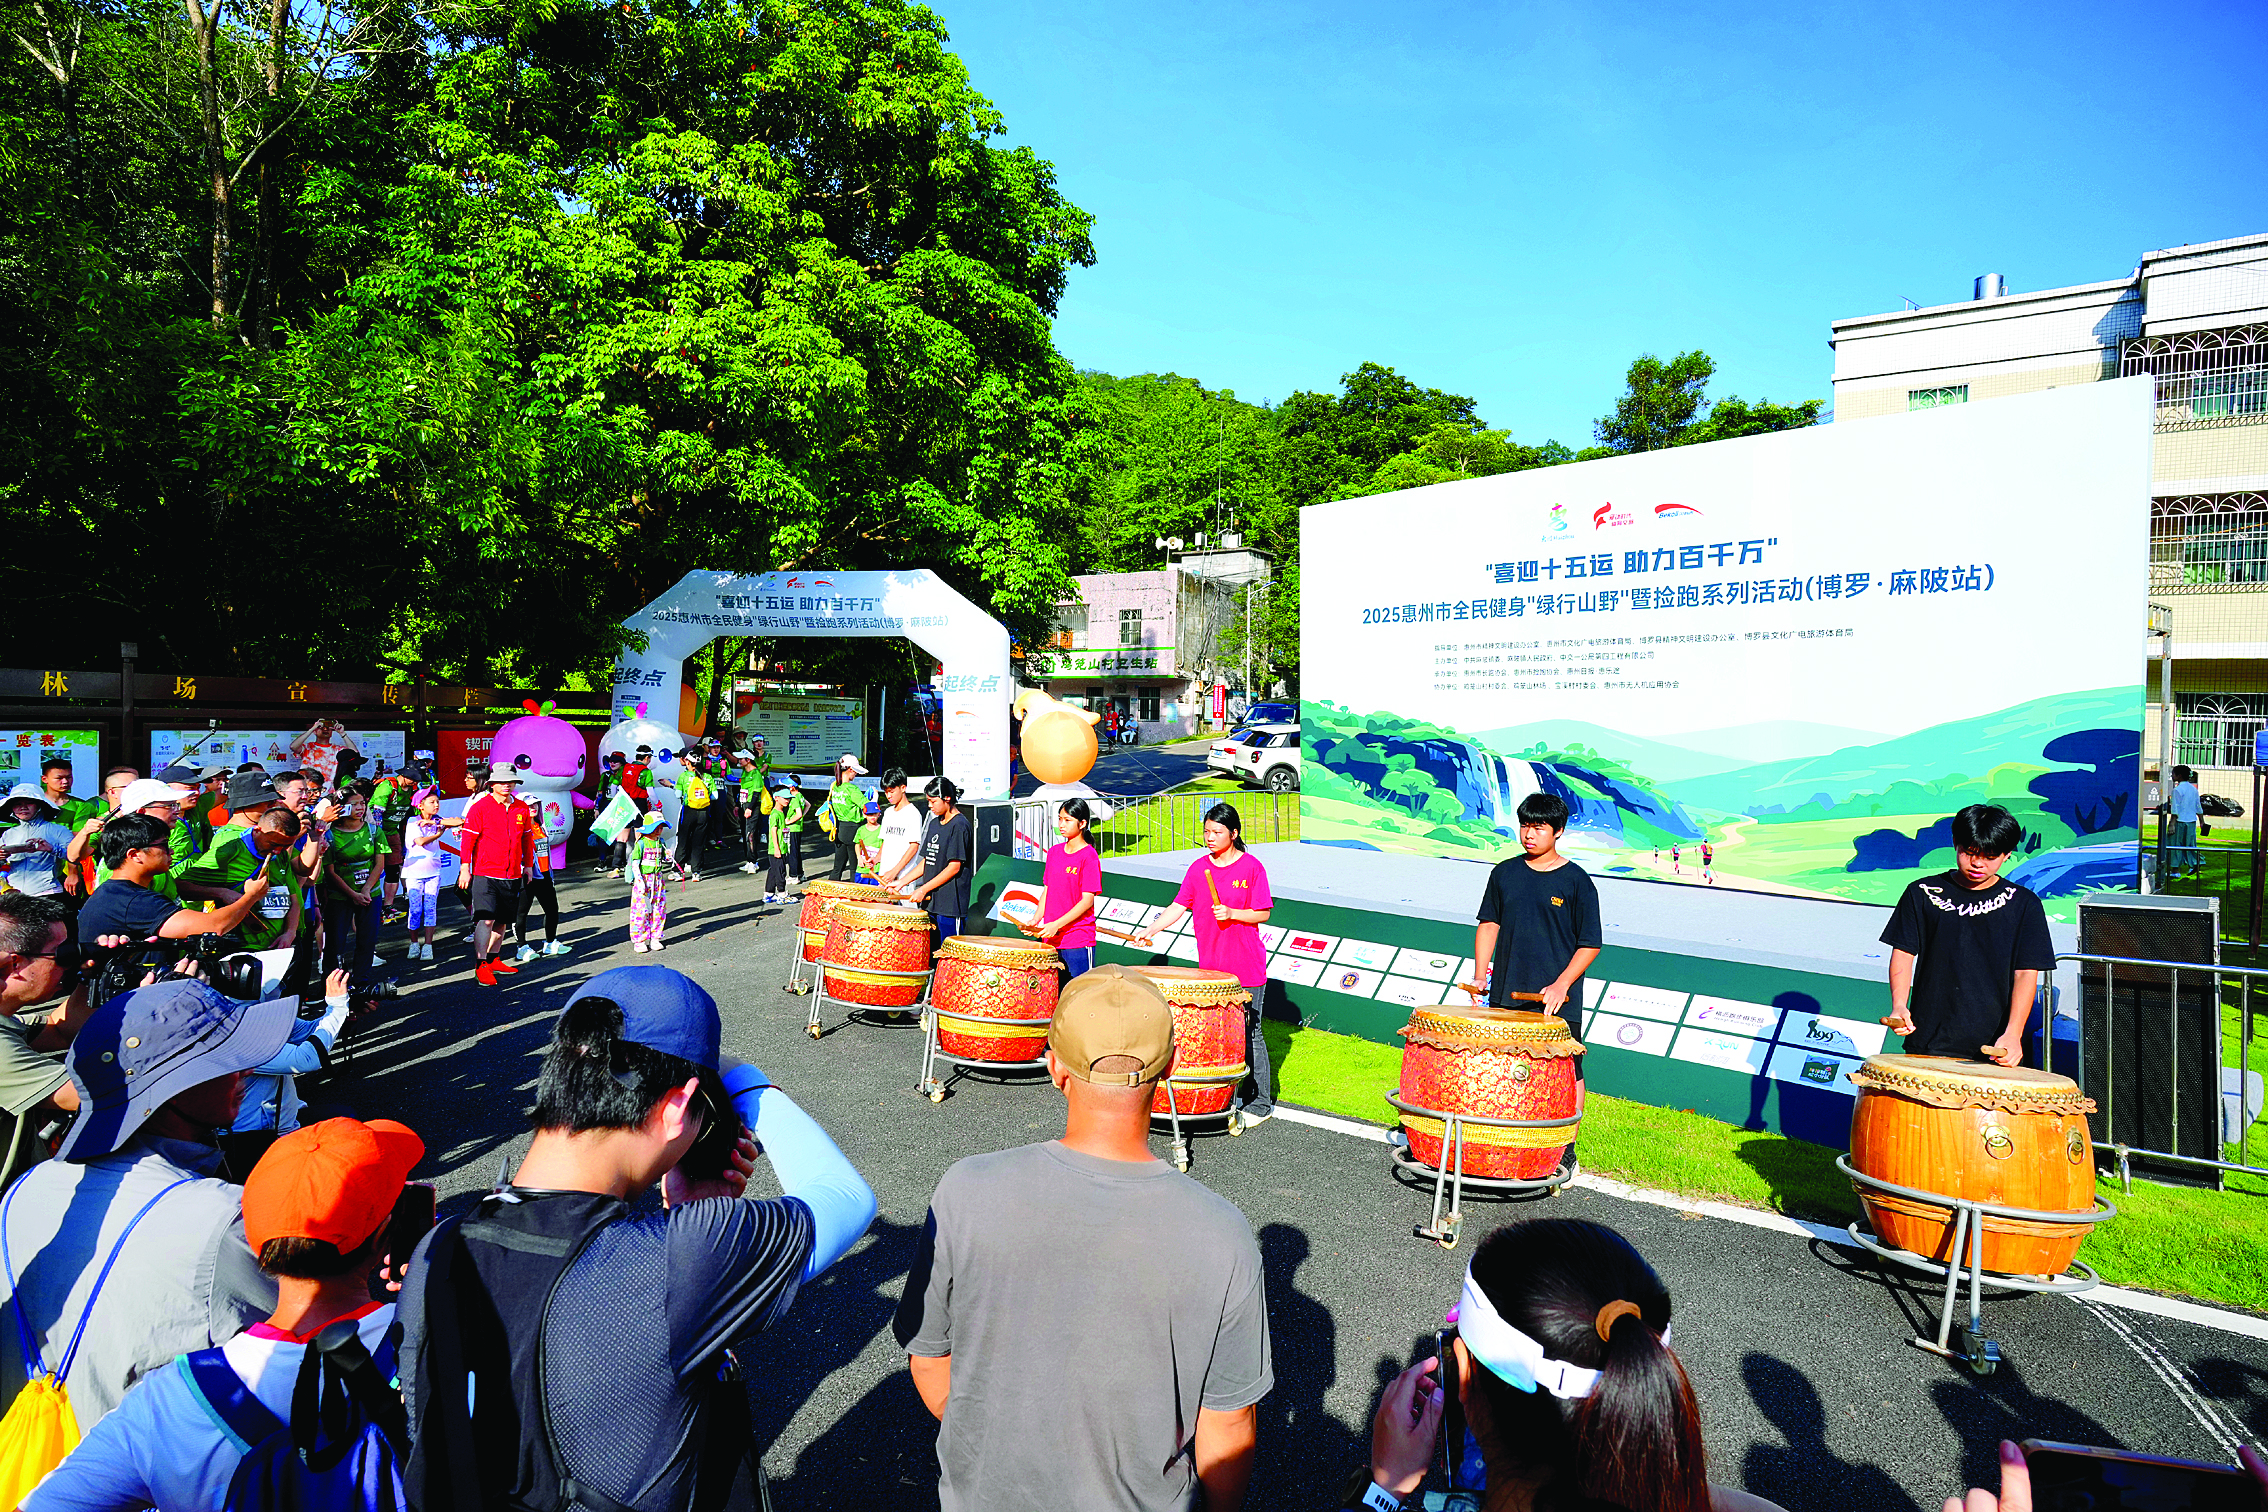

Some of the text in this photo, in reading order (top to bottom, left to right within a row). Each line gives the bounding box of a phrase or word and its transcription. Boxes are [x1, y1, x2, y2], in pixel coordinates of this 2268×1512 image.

[1623, 537, 1778, 574] 助力百千万"
[944, 674, 1001, 693] 起终点
